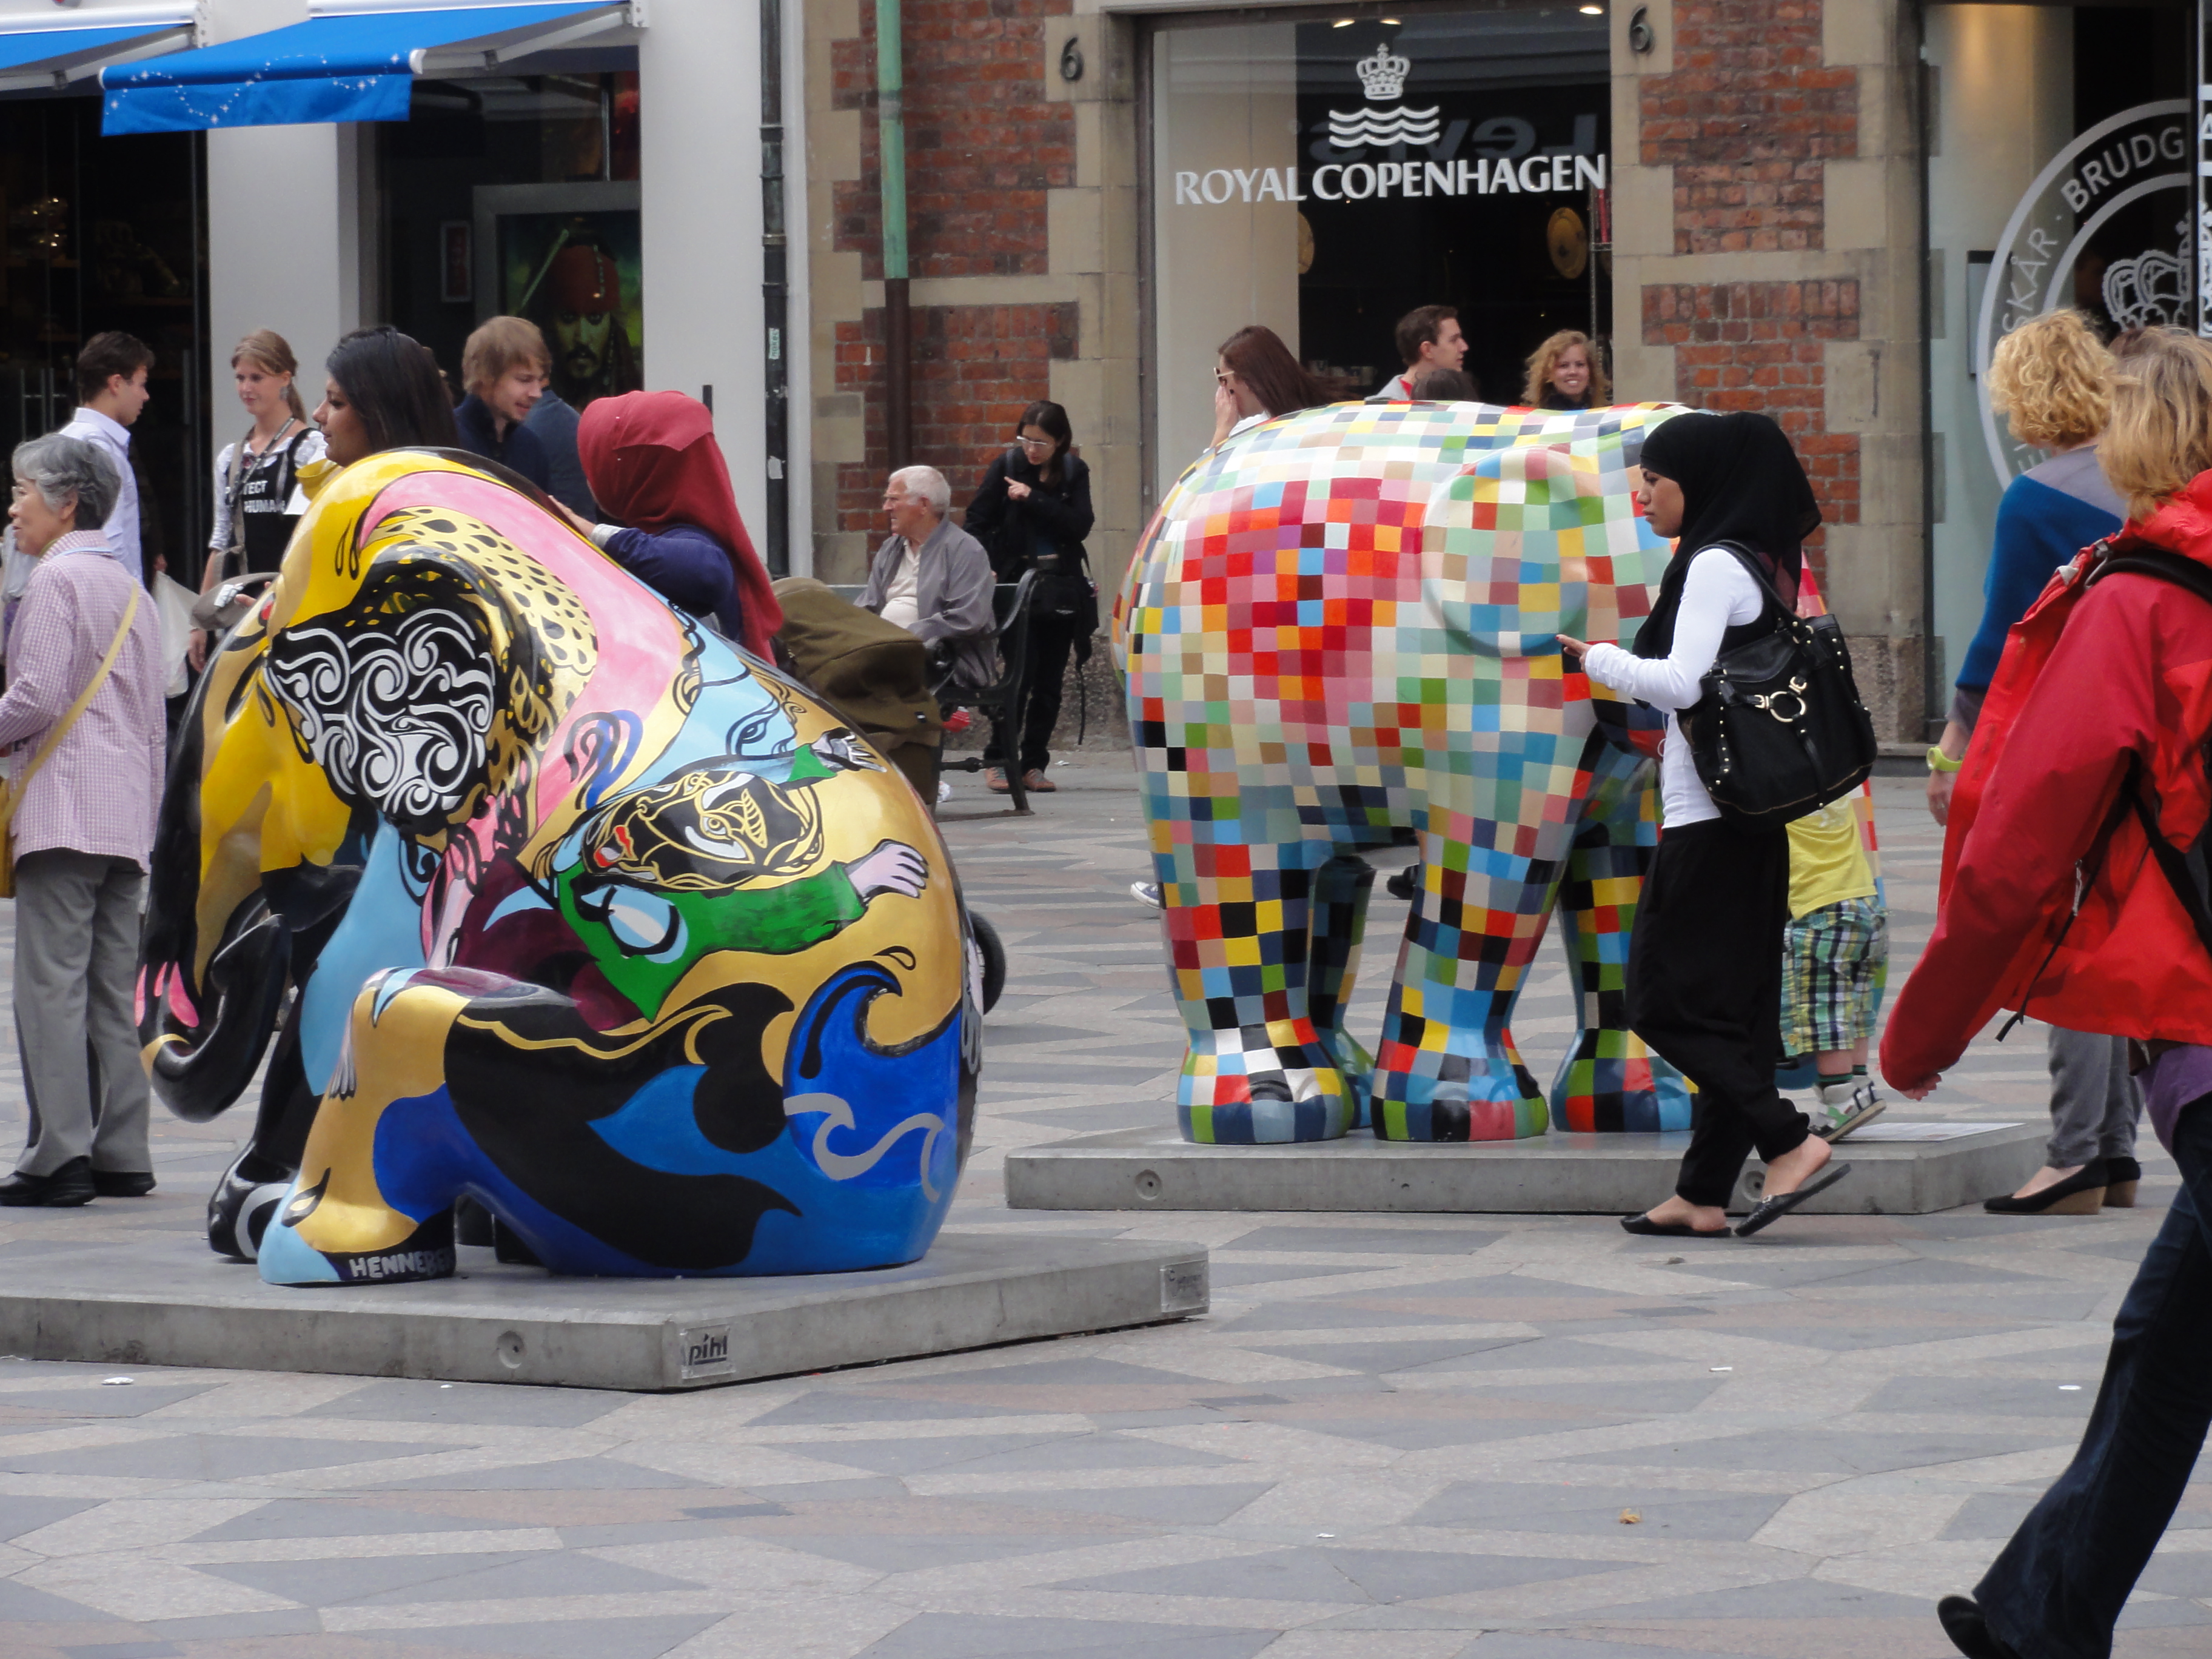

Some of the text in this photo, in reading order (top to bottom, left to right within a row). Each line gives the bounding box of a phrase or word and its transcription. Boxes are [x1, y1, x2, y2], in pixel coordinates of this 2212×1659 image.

[1629, 6, 1653, 53] 6
[1061, 37, 1084, 82] 6
[1175, 154, 1607, 205] ROYAL COPENHAGEN
